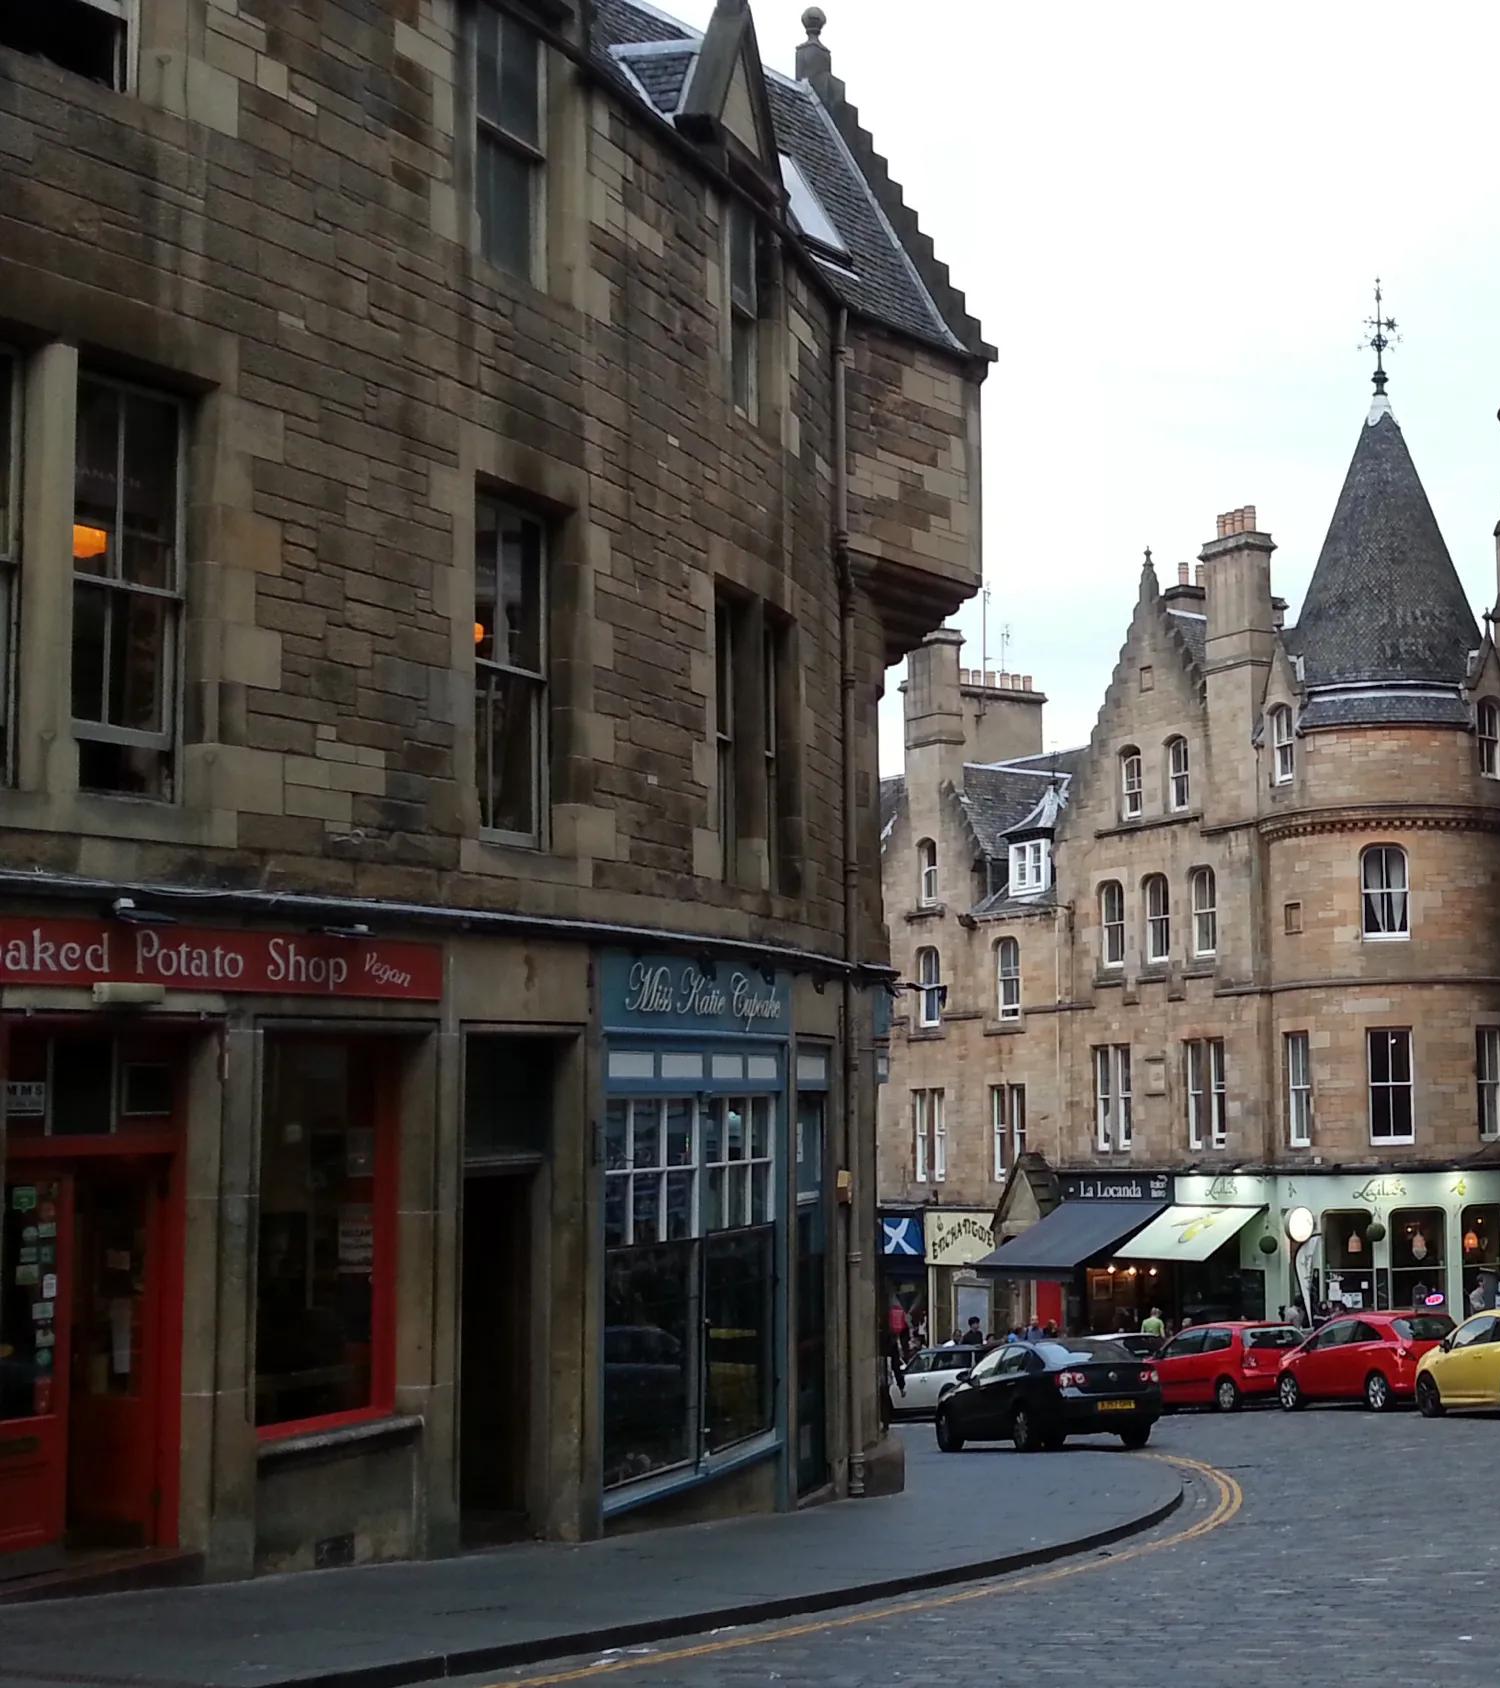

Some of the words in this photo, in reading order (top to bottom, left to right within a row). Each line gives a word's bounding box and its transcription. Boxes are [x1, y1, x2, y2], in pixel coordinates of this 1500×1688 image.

[0, 928, 110, 973] aked
[136, 929, 244, 979] Potato
[267, 937, 348, 991] Shop
[364, 951, 411, 988] Vegan
[625, 961, 673, 1013] Miss
[675, 966, 726, 1016] Katie
[730, 971, 782, 1032] Cupcake
[1079, 1181, 1094, 1198] La
[1097, 1180, 1142, 1198] Locanda
